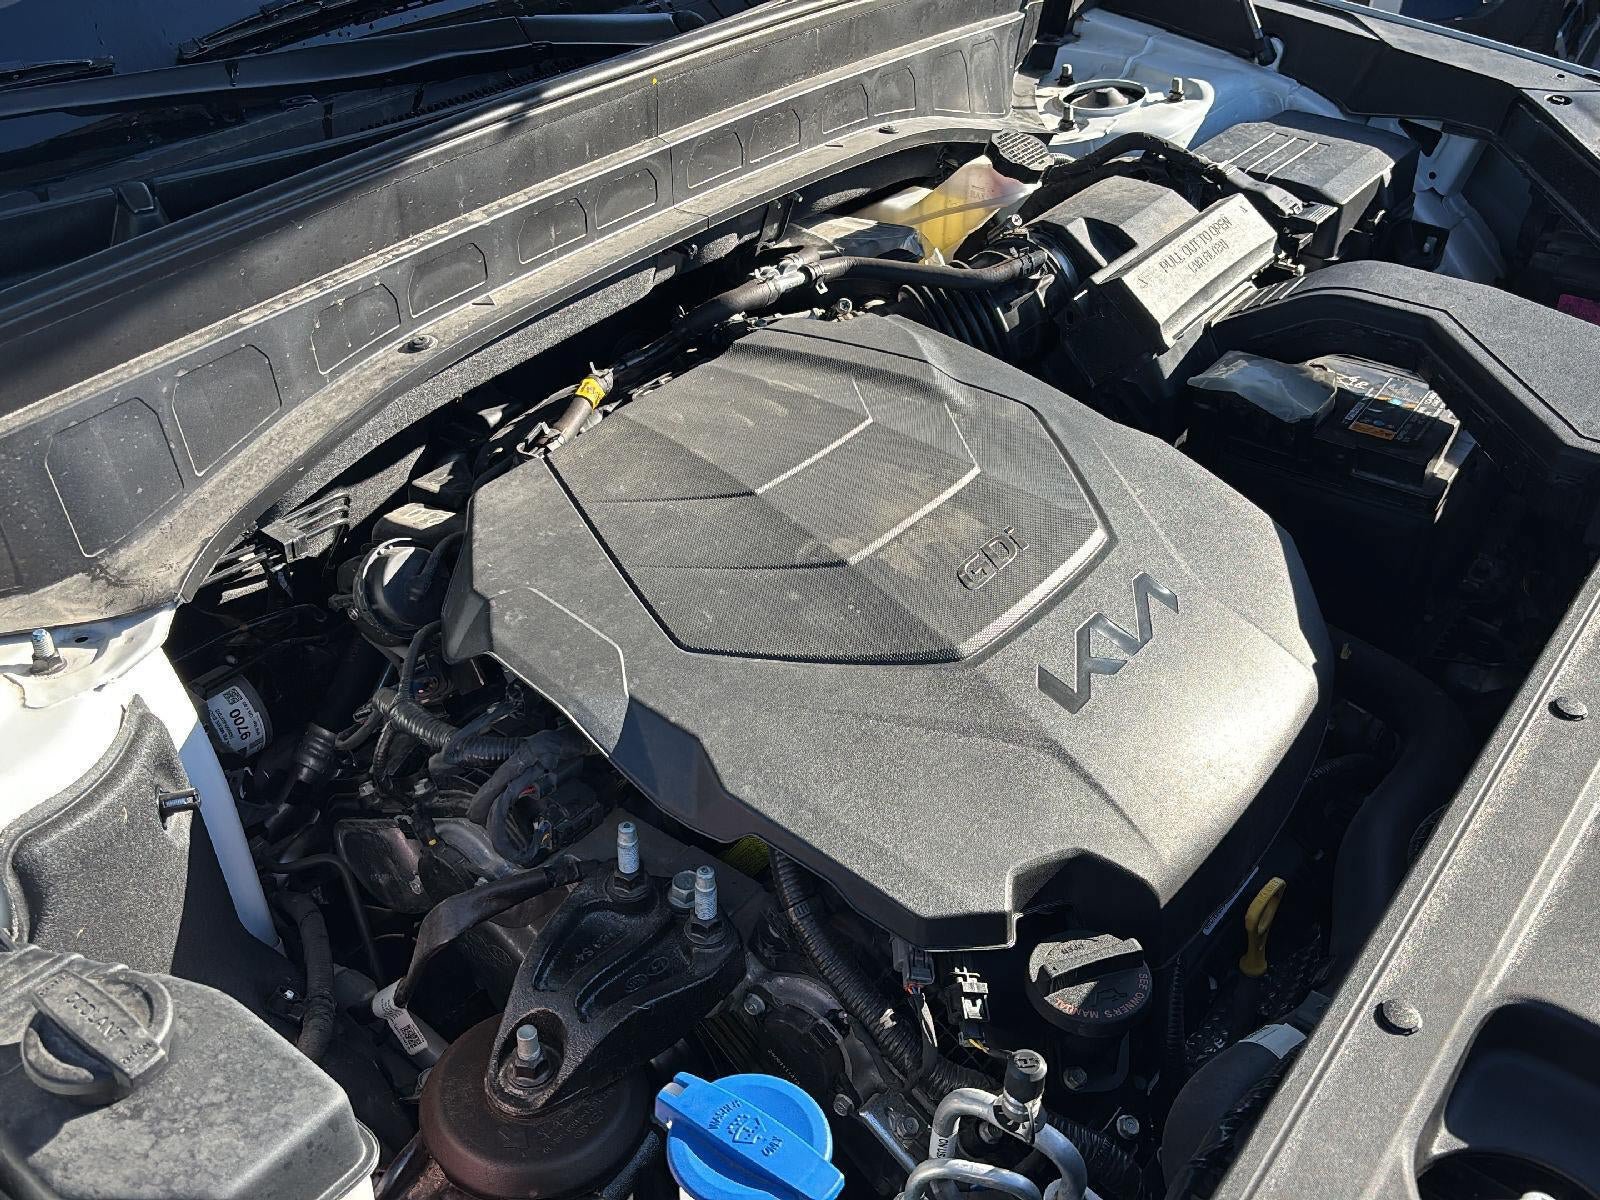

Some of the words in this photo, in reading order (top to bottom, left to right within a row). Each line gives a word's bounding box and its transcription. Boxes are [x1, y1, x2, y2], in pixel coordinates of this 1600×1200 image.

[1158, 251, 1186, 274] PULL
[1180, 238, 1201, 258] OUT
[1198, 230, 1213, 246] TO
[1208, 214, 1233, 237] OPEN
[229, 708, 251, 741] 9700
[1138, 973, 1149, 991] SEE
[1055, 997, 1100, 1018] MANUAL
[1104, 992, 1146, 1018] OWNER'S
